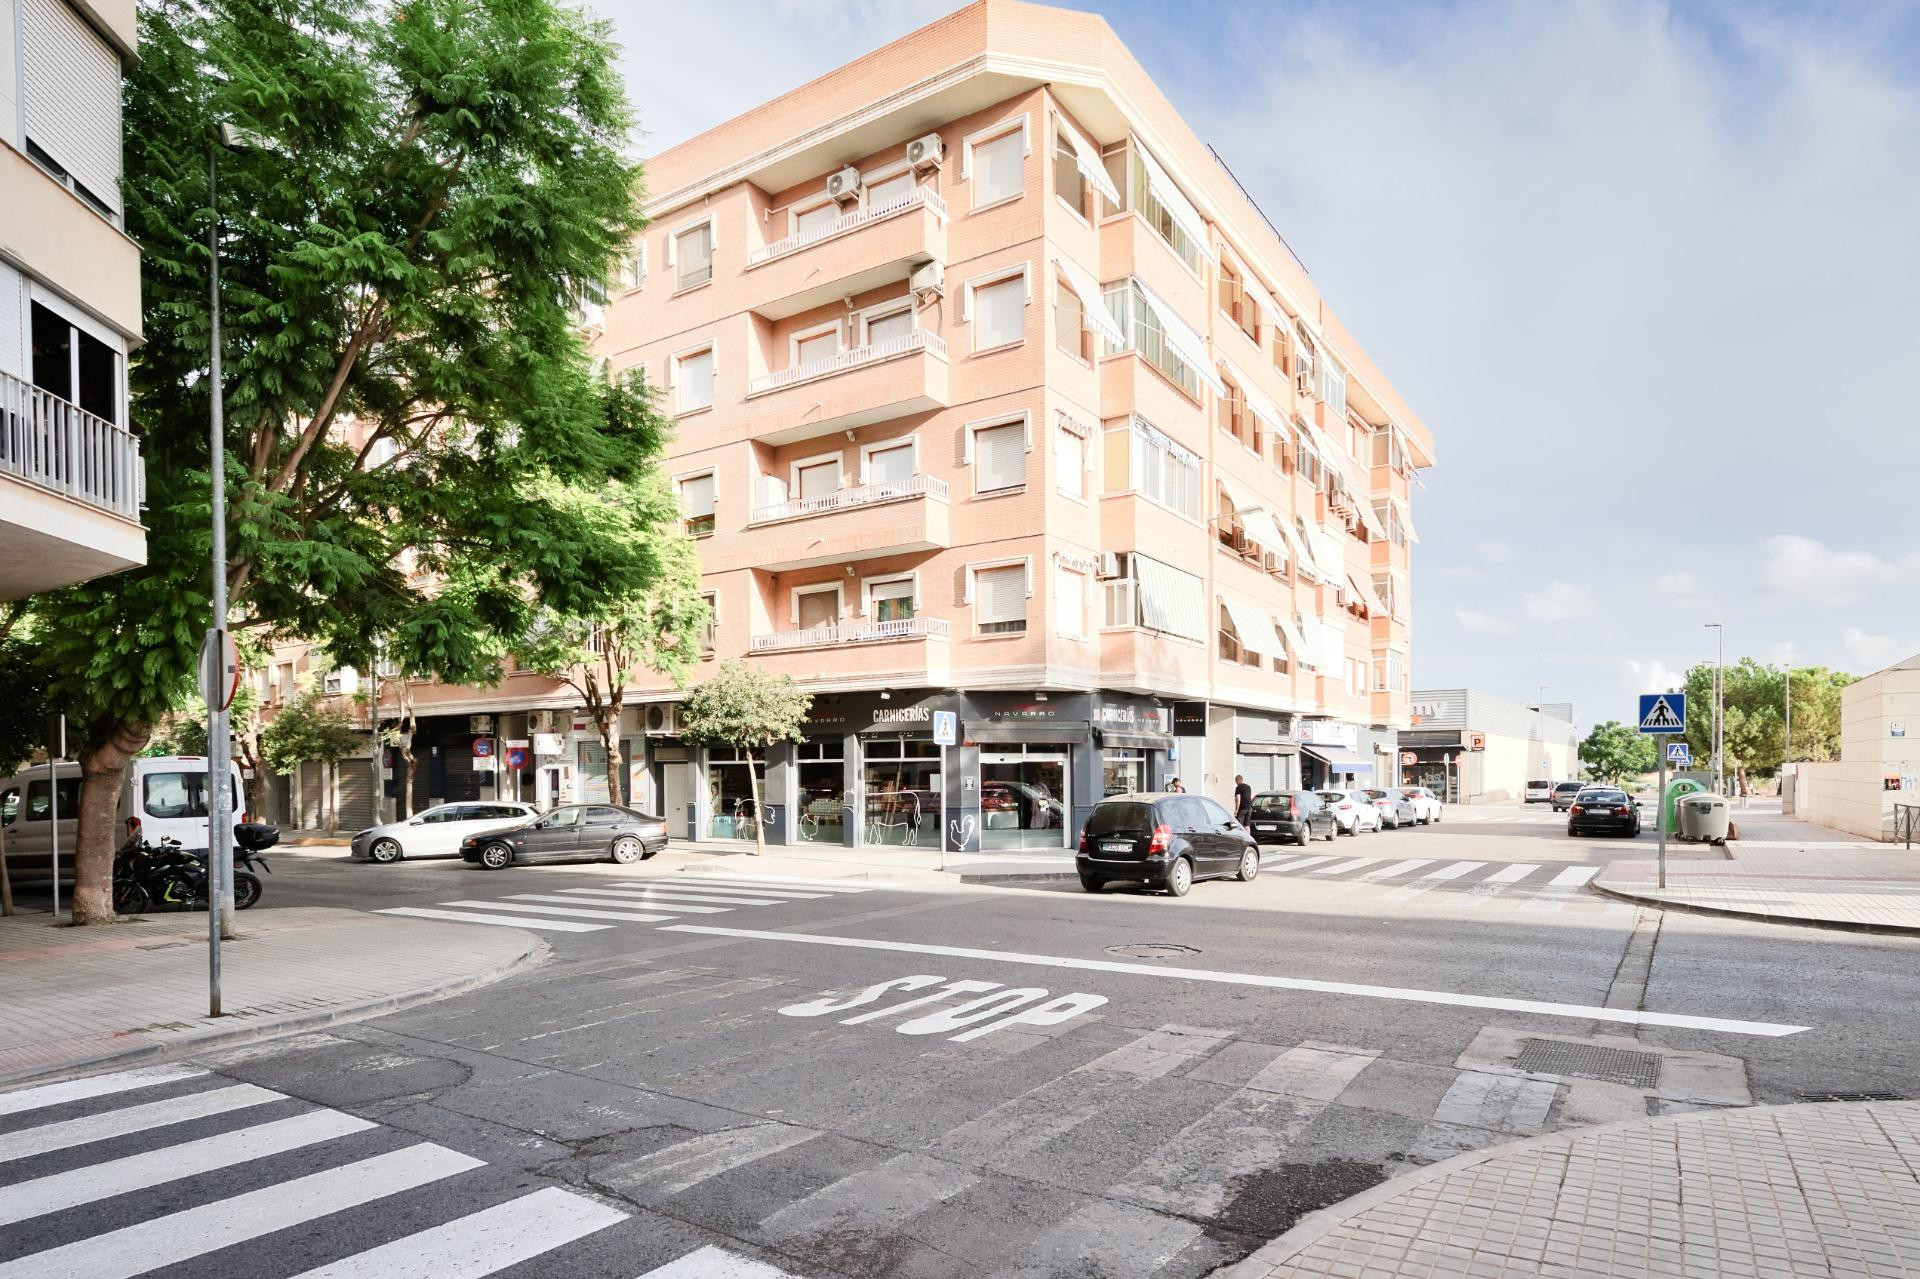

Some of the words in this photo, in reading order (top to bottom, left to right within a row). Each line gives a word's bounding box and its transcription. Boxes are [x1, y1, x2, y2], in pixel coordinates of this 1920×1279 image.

[873, 706, 930, 723] CARNICERÍAS
[1474, 738, 1481, 746] P
[778, 974, 1109, 1042] STOP
